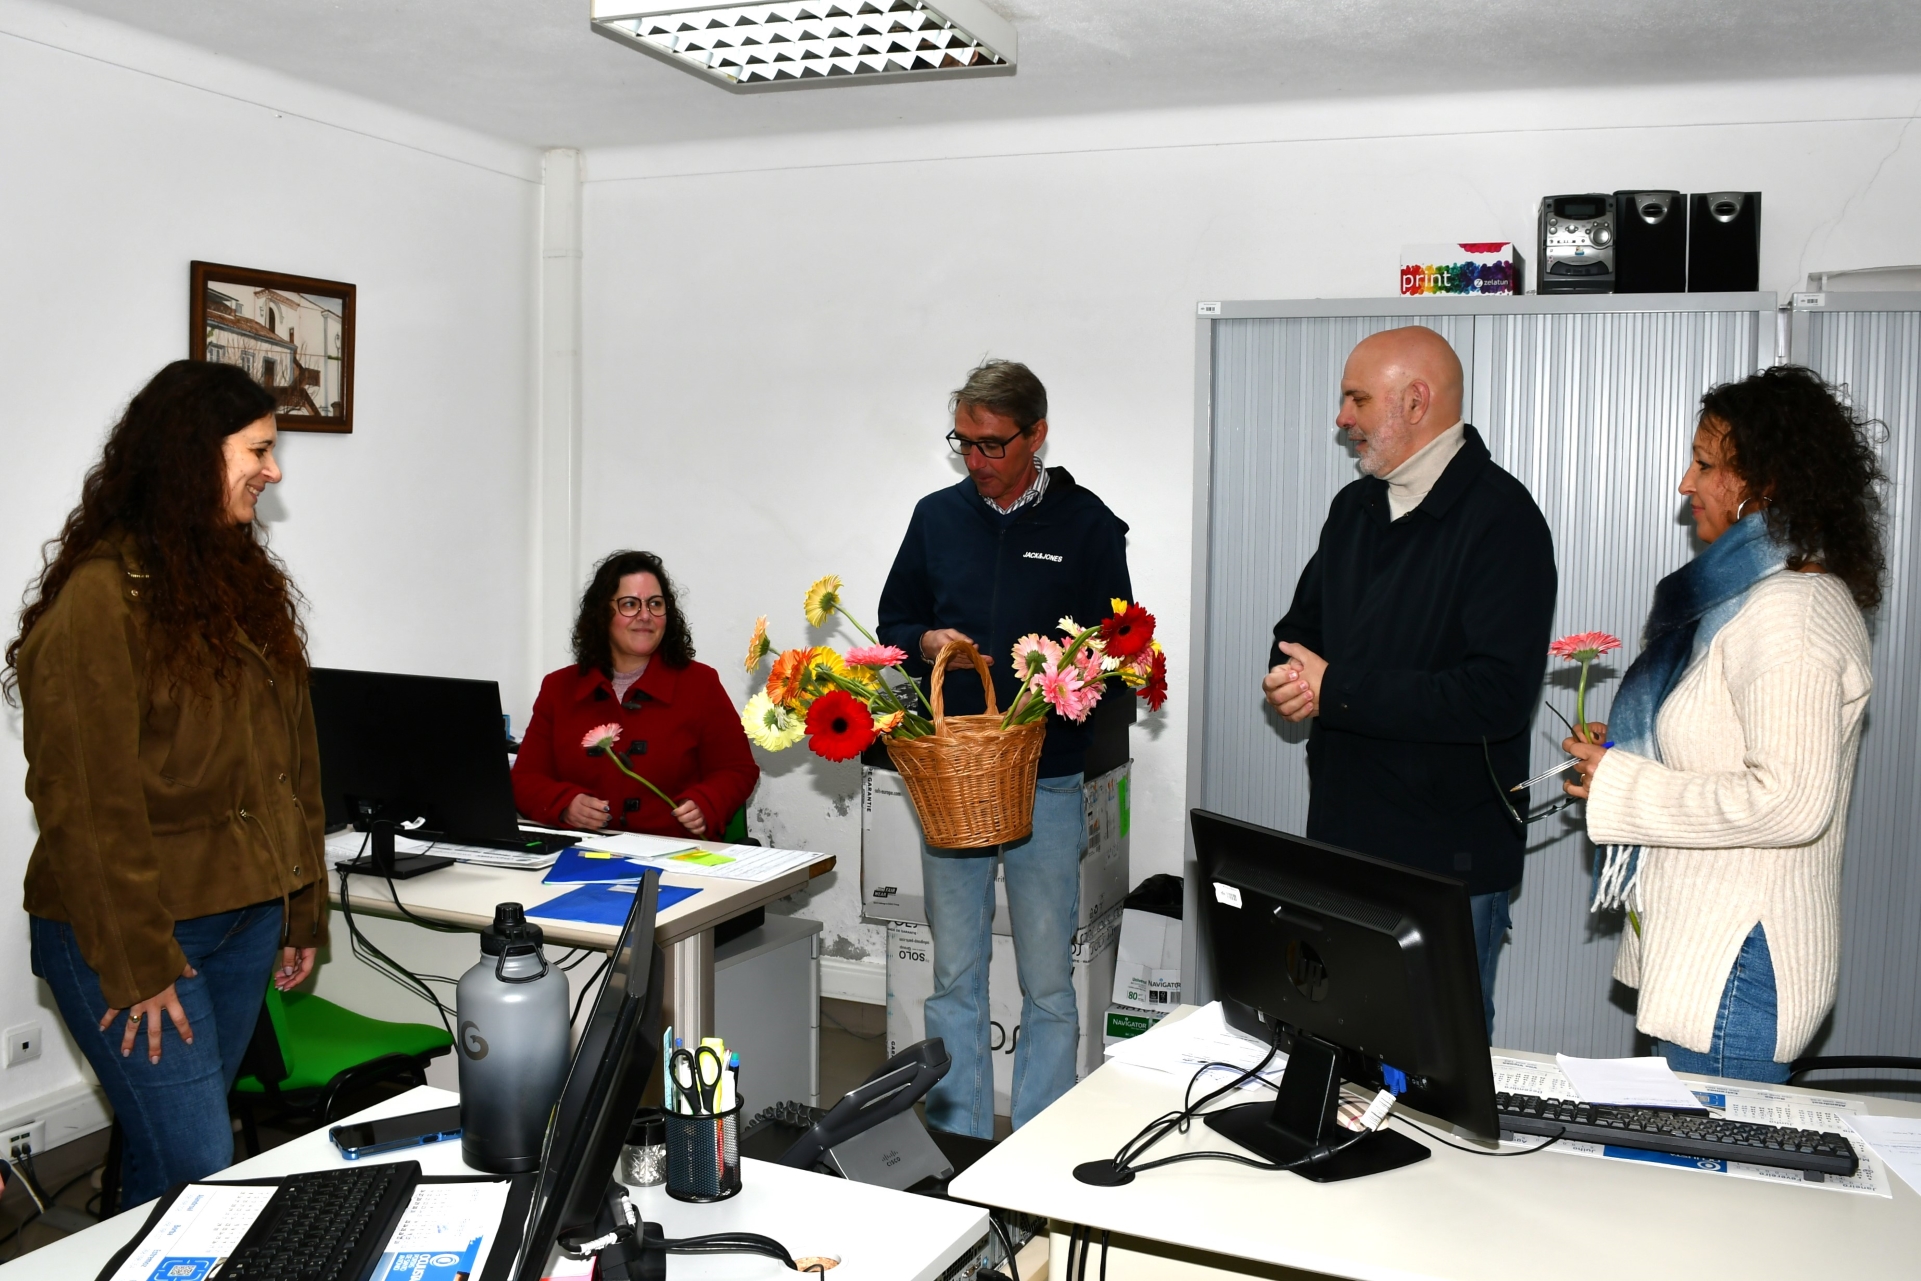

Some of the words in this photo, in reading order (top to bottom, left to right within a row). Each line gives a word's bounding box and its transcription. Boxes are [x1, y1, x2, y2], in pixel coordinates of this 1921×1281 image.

[1402, 270, 1451, 291] print
[1022, 551, 1063, 563] JACK&JONES
[899, 950, 926, 962] SOLO
[1148, 980, 1182, 988] NAVIGATOR
[1128, 991, 1138, 1001] 80
[1112, 1018, 1147, 1029] NAVIGATOR
[886, 1156, 901, 1167] CISCO
[1842, 1183, 1877, 1191] Janeiro
[408, 1253, 431, 1281] OCULIST
